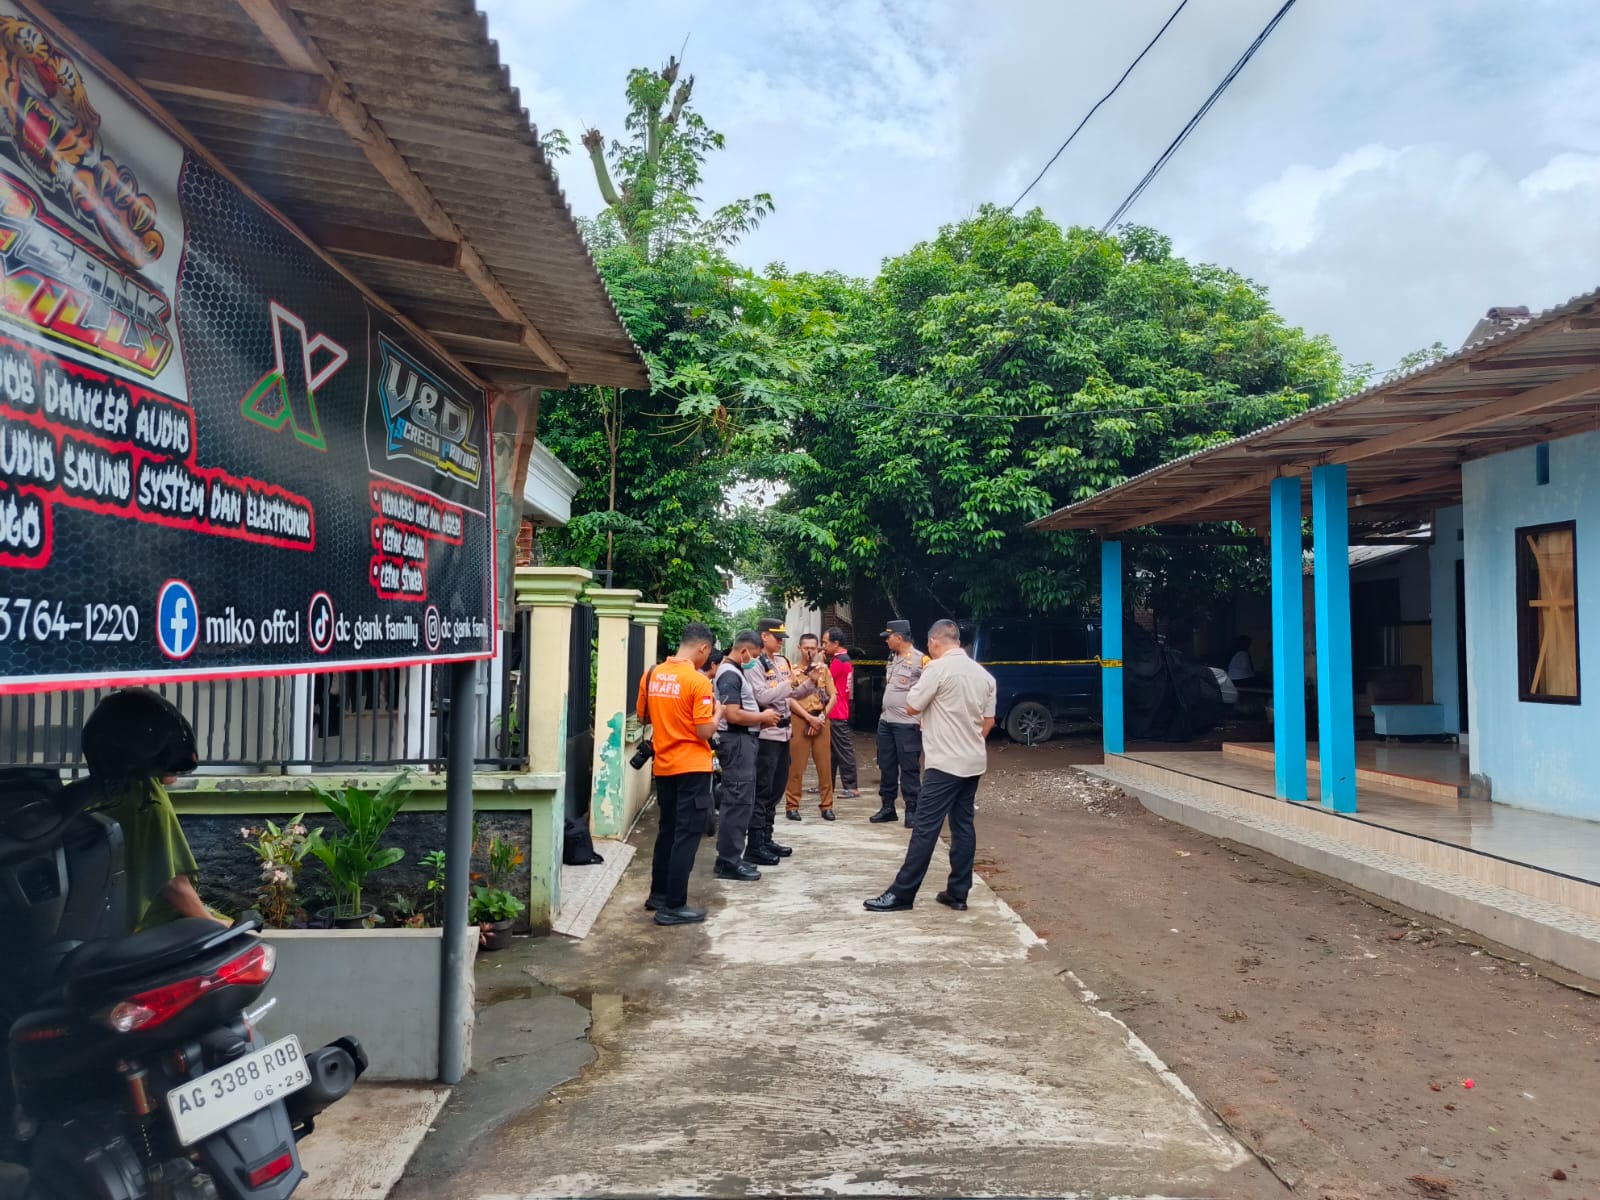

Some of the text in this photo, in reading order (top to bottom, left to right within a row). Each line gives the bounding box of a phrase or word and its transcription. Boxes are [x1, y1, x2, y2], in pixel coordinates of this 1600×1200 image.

[0, 353, 189, 453] OB DANCER AUDIO
[394, 417, 440, 452] SCREEN
[0, 426, 310, 538] UDIO SOUND SYSTEM DAN ELEKTRONIK
[0, 494, 40, 548] GO
[206, 606, 300, 644] miko offcl
[335, 612, 418, 650] dc gank familly
[441, 615, 451, 639] dc
[453, 617, 472, 645] gank
[648, 680, 681, 695] INAFIS
[656, 673, 678, 682] POLICE
[179, 1087, 206, 1115] AG
[210, 1060, 261, 1099] 3388
